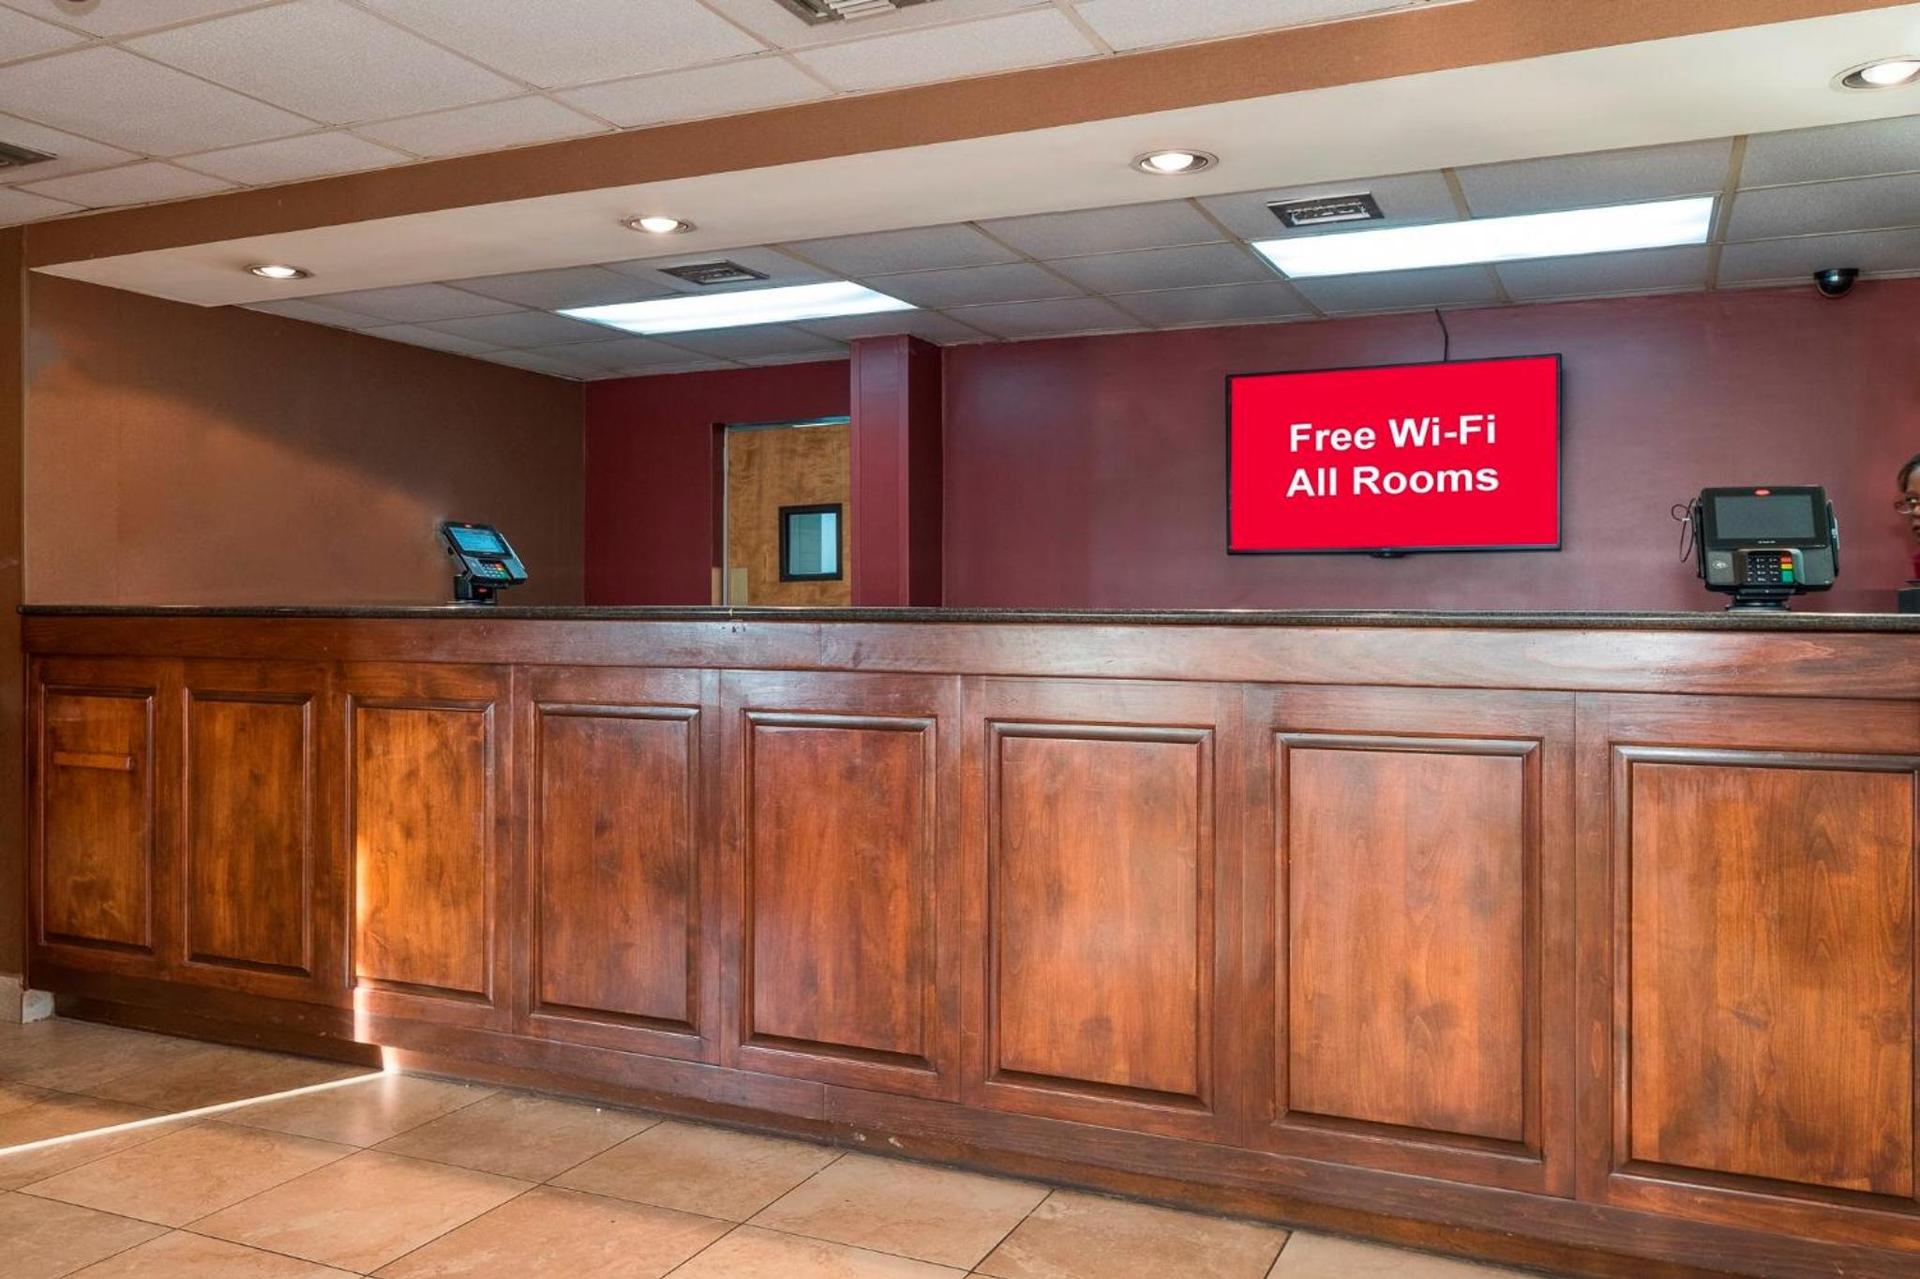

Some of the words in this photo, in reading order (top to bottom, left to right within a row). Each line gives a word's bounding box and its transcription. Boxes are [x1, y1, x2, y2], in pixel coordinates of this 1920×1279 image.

[1290, 423, 1376, 453] Free
[1388, 414, 1496, 448] Wi-Fi
[1286, 467, 1337, 497] All
[1353, 465, 1499, 495] Rooms
